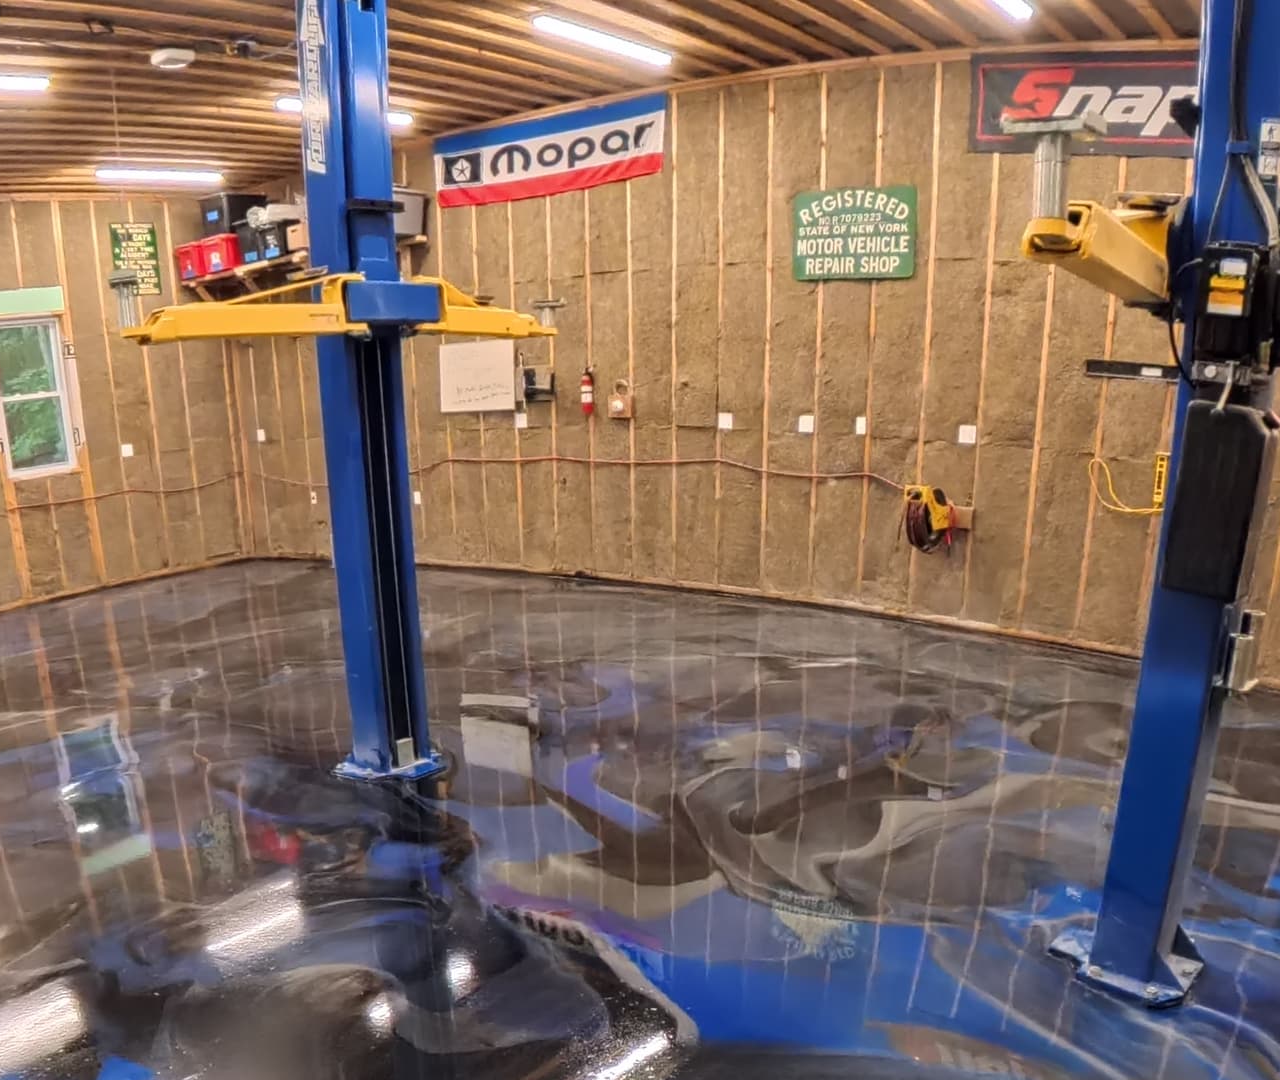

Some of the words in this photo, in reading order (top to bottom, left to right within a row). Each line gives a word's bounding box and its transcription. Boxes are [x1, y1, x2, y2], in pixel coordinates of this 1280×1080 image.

[304, 41, 327, 174] FORARD
[799, 190, 909, 225] REGISTERED
[799, 226, 829, 237] STATE
[833, 225, 847, 235] OF
[850, 224, 875, 234] NEW
[878, 222, 908, 233] YORK
[797, 238, 843, 256] MOTOR
[847, 236, 910, 254] VEHICLE
[805, 256, 855, 275] REPAIR
[860, 256, 900, 273] SHOP
